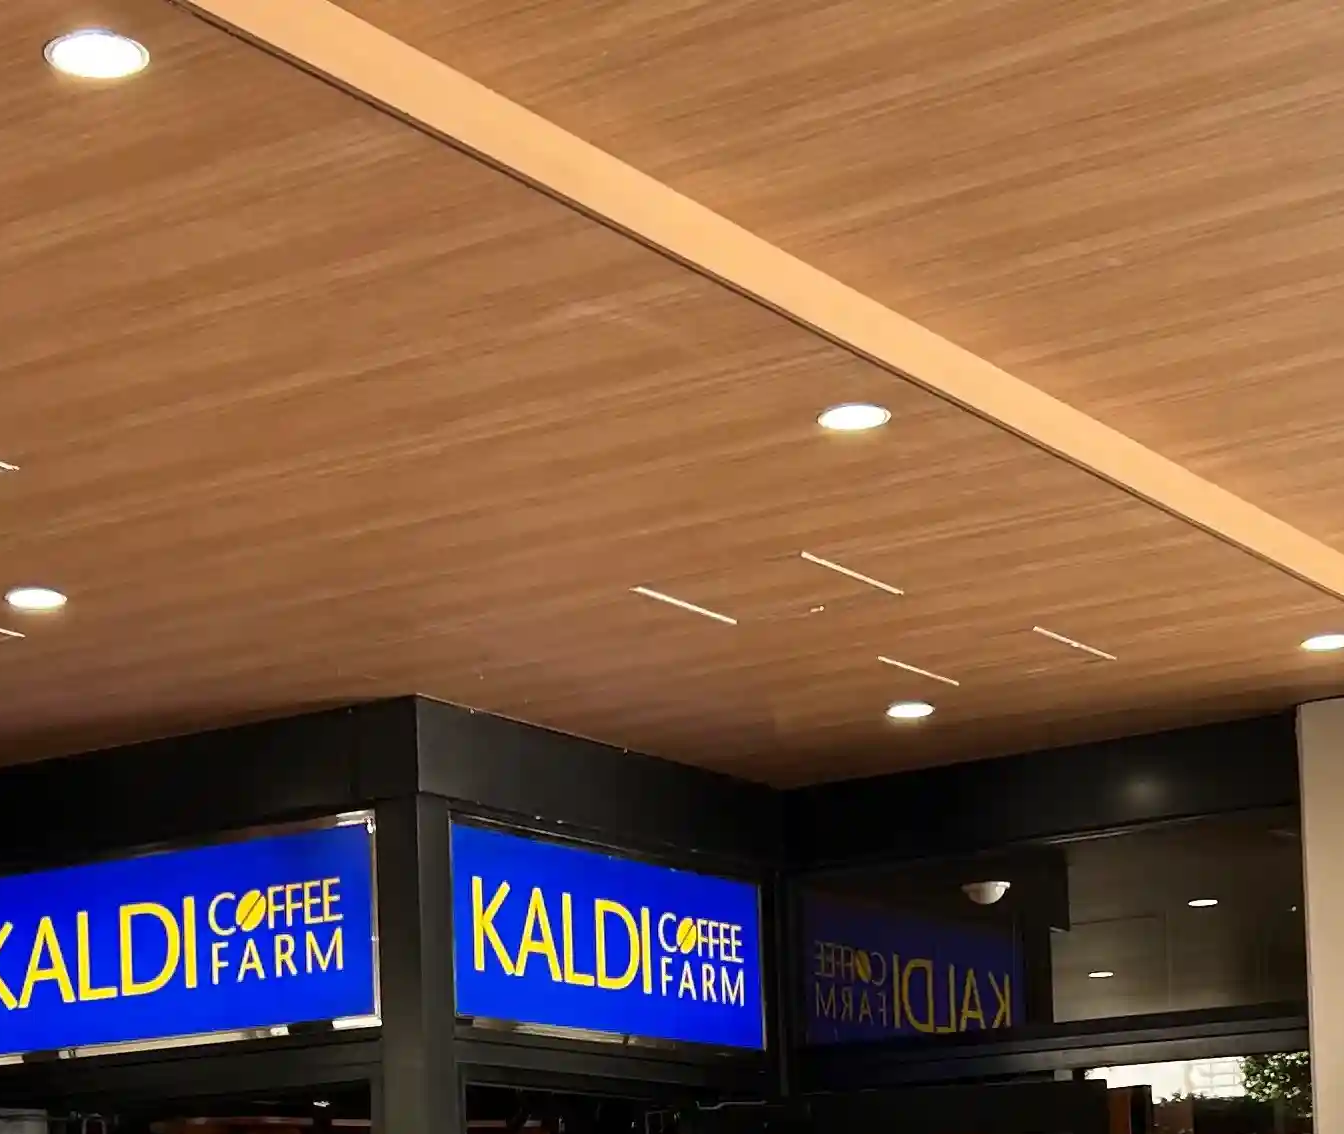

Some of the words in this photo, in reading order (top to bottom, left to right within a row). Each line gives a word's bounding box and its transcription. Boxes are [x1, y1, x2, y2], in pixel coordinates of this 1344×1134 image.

[208, 876, 344, 936] COFFEE
[471, 876, 652, 995] KALDI
[212, 926, 344, 985] FARM
[658, 912, 744, 964] COFFEE
[660, 956, 745, 1008] FARM
